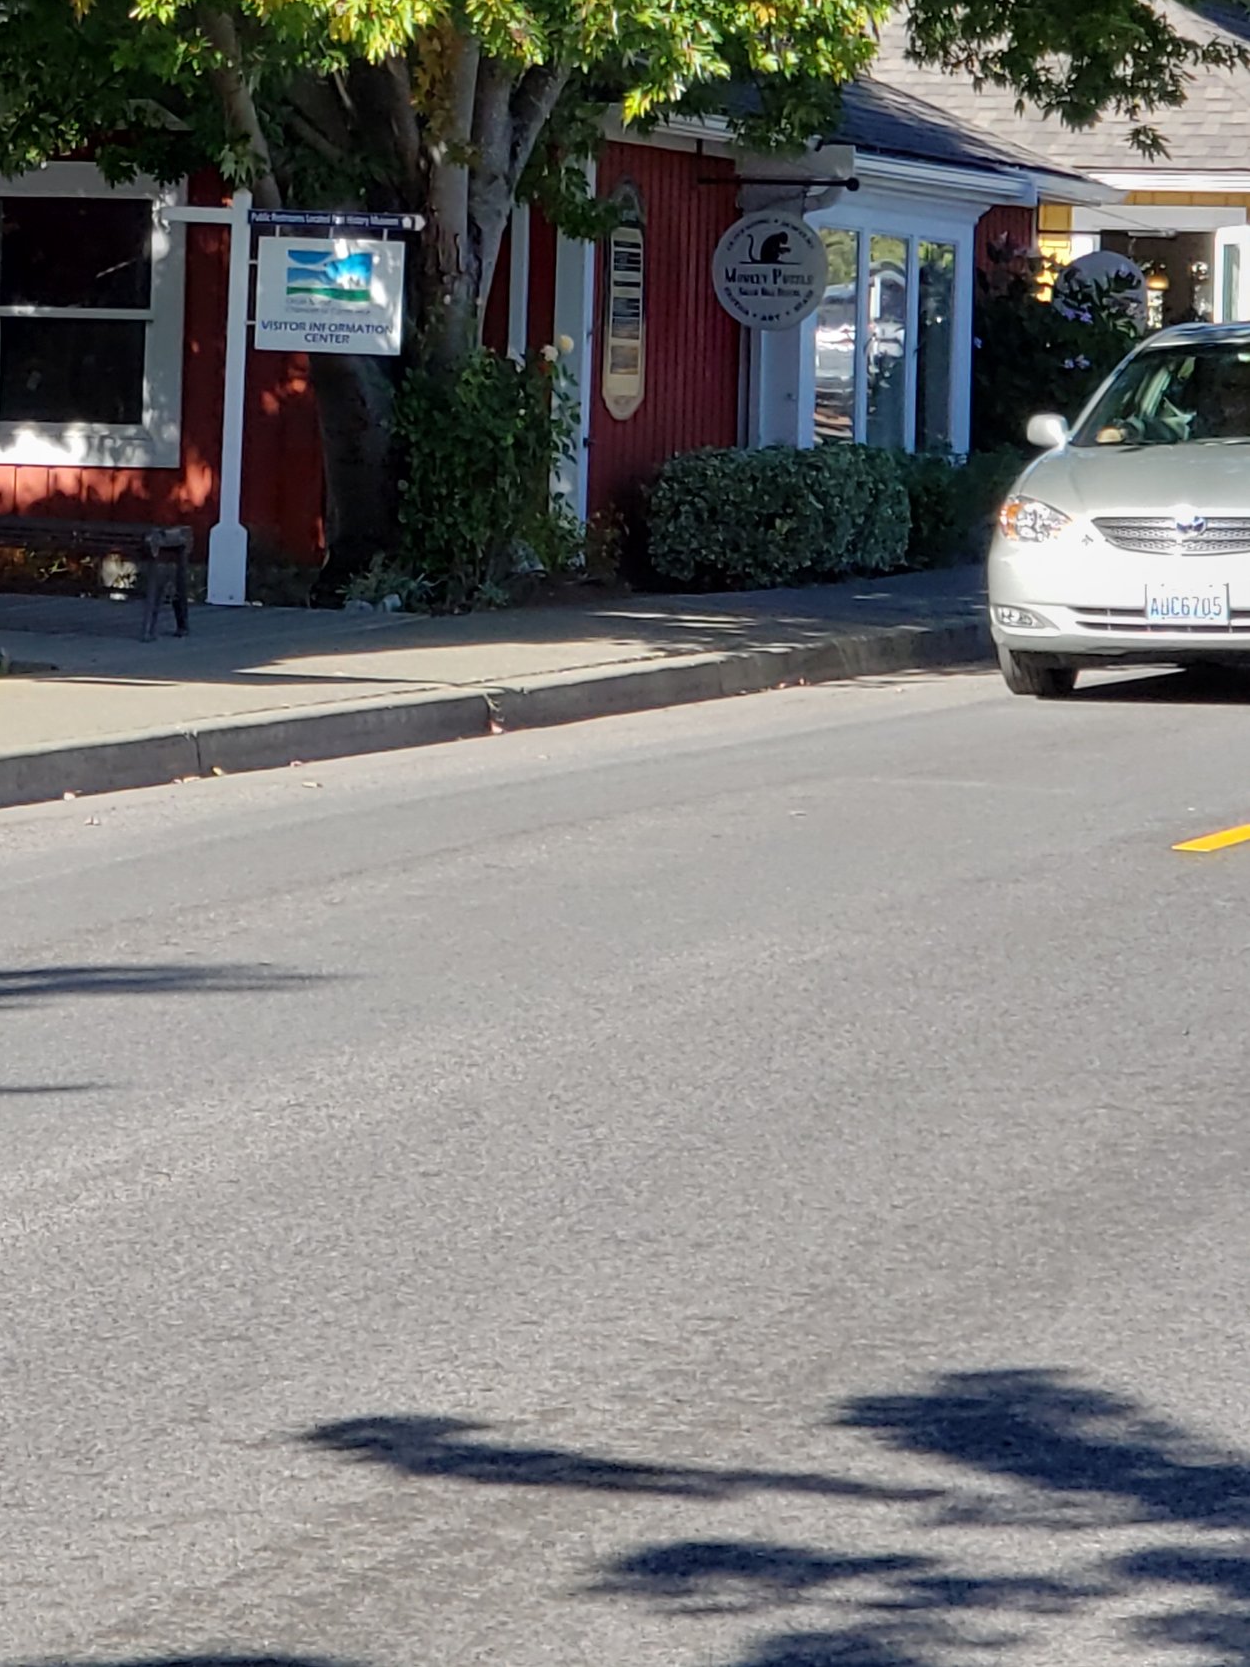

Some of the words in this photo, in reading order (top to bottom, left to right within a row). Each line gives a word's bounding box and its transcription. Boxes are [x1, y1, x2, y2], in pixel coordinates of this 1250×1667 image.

[261, 320, 306, 331] VISITOR
[309, 321, 393, 334] INFORMATION
[304, 333, 350, 344] CENTER
[1151, 596, 1221, 616] AUC6705
